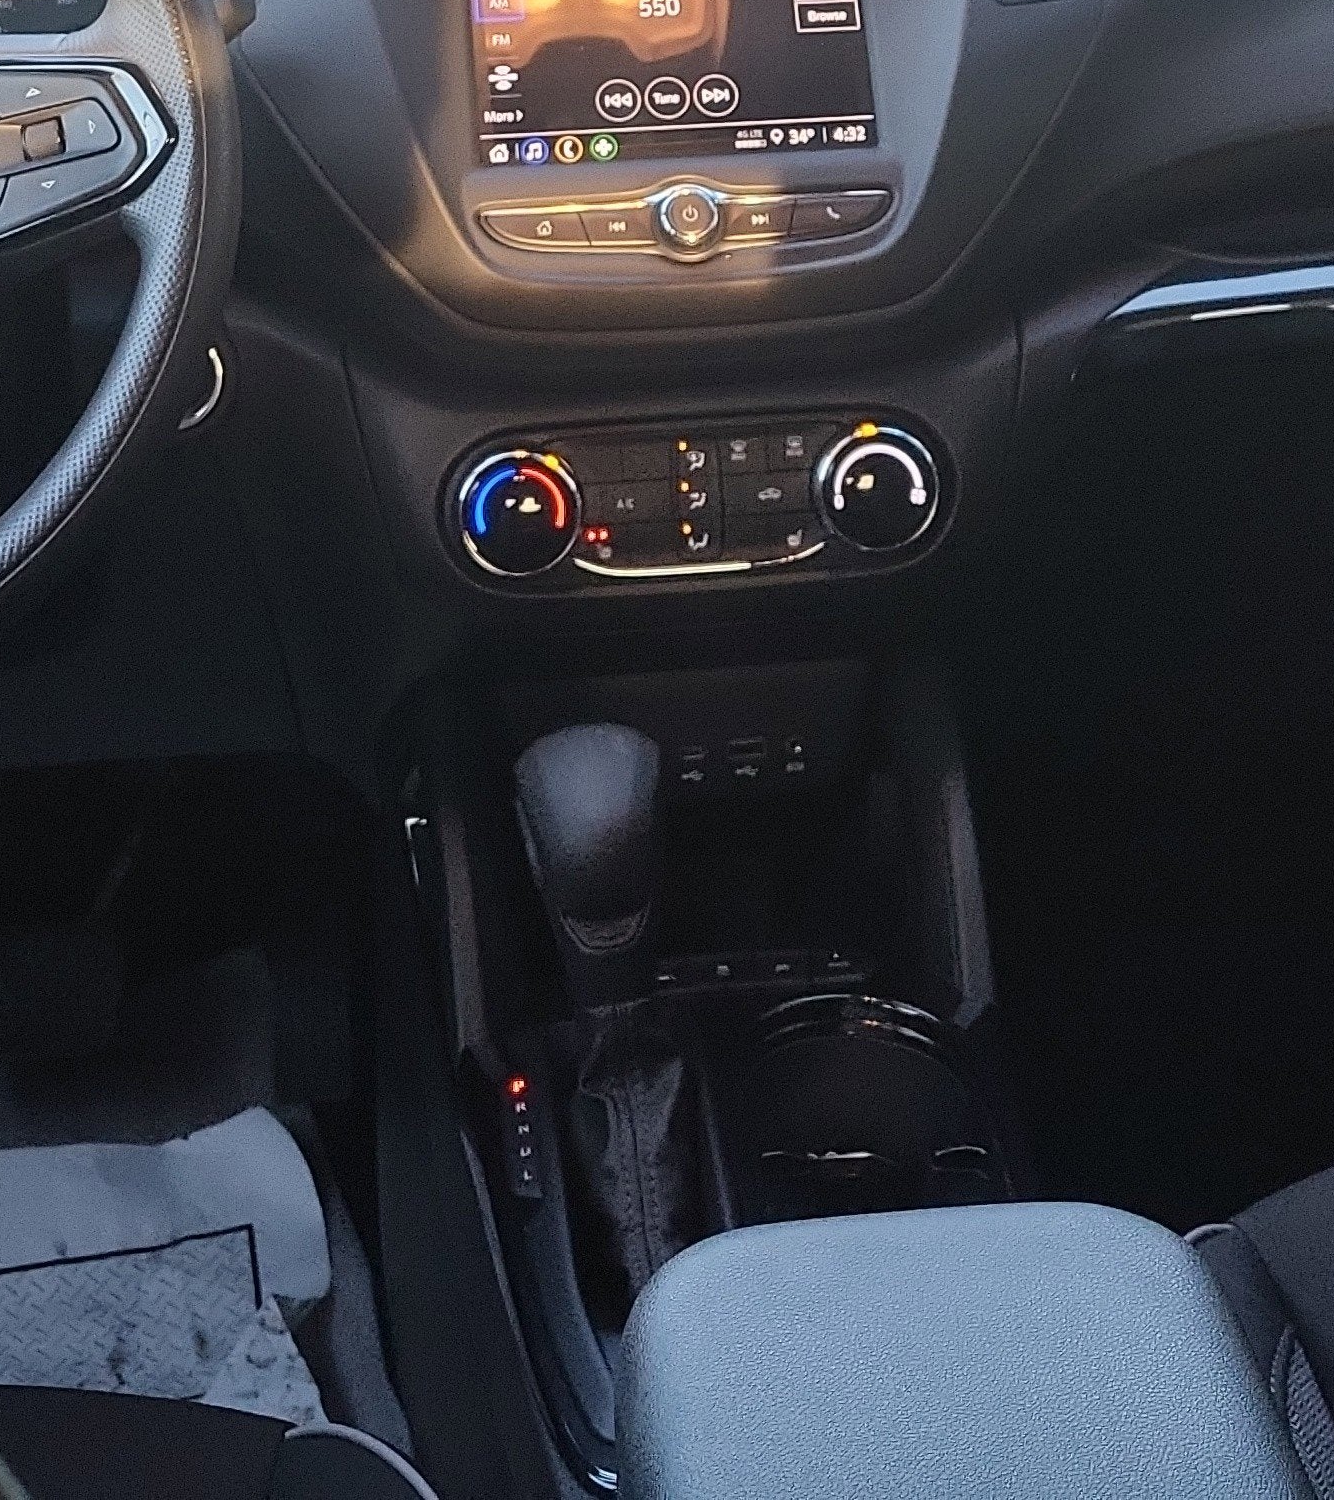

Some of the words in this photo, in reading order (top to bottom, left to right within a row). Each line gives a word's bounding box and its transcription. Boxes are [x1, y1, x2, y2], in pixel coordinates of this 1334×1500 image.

[807, 10, 847, 23] Browse
[492, 33, 512, 47] FM
[652, 92, 681, 105] Tune
[484, 111, 515, 124] More
[512, 1080, 525, 1093] P
[518, 1122, 530, 1135] N
[524, 1169, 533, 1181] L
